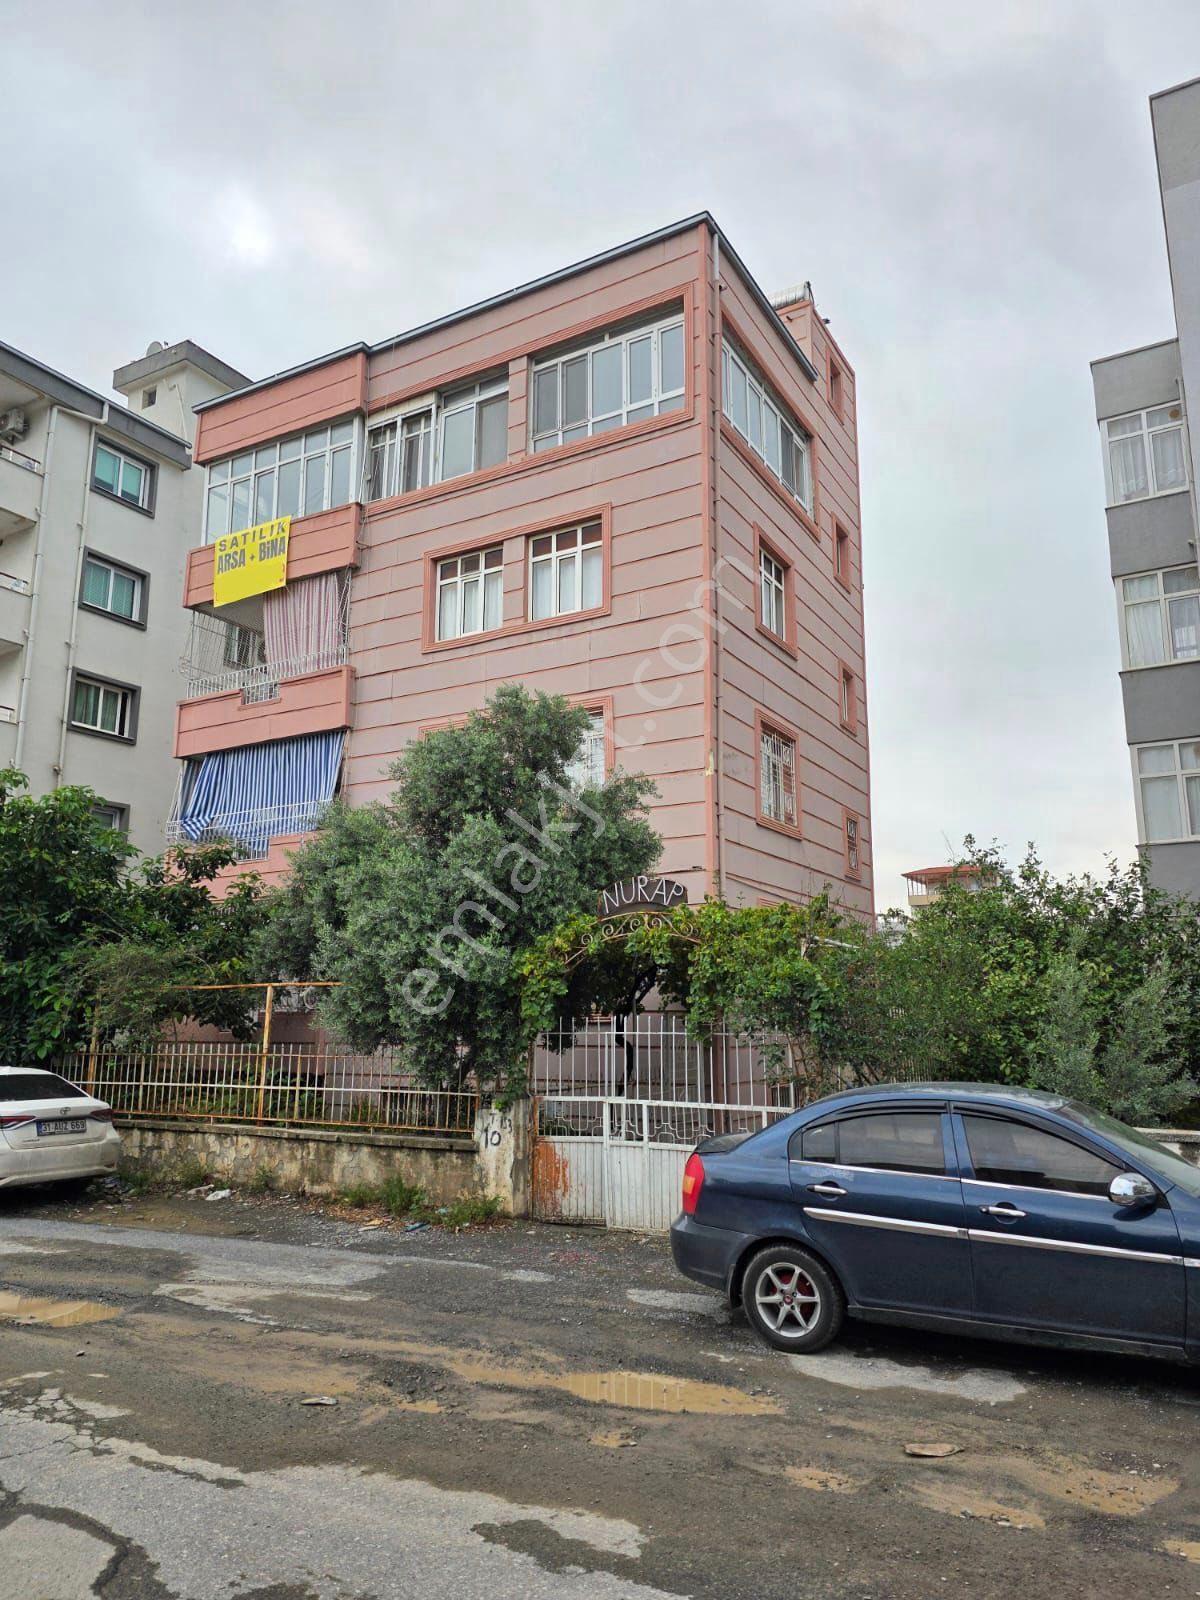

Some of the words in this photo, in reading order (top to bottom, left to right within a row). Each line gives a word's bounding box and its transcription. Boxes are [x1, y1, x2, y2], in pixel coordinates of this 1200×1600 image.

[218, 521, 286, 552] SATILIK
[217, 548, 246, 574] ARSA
[483, 1123, 502, 1149] 10
